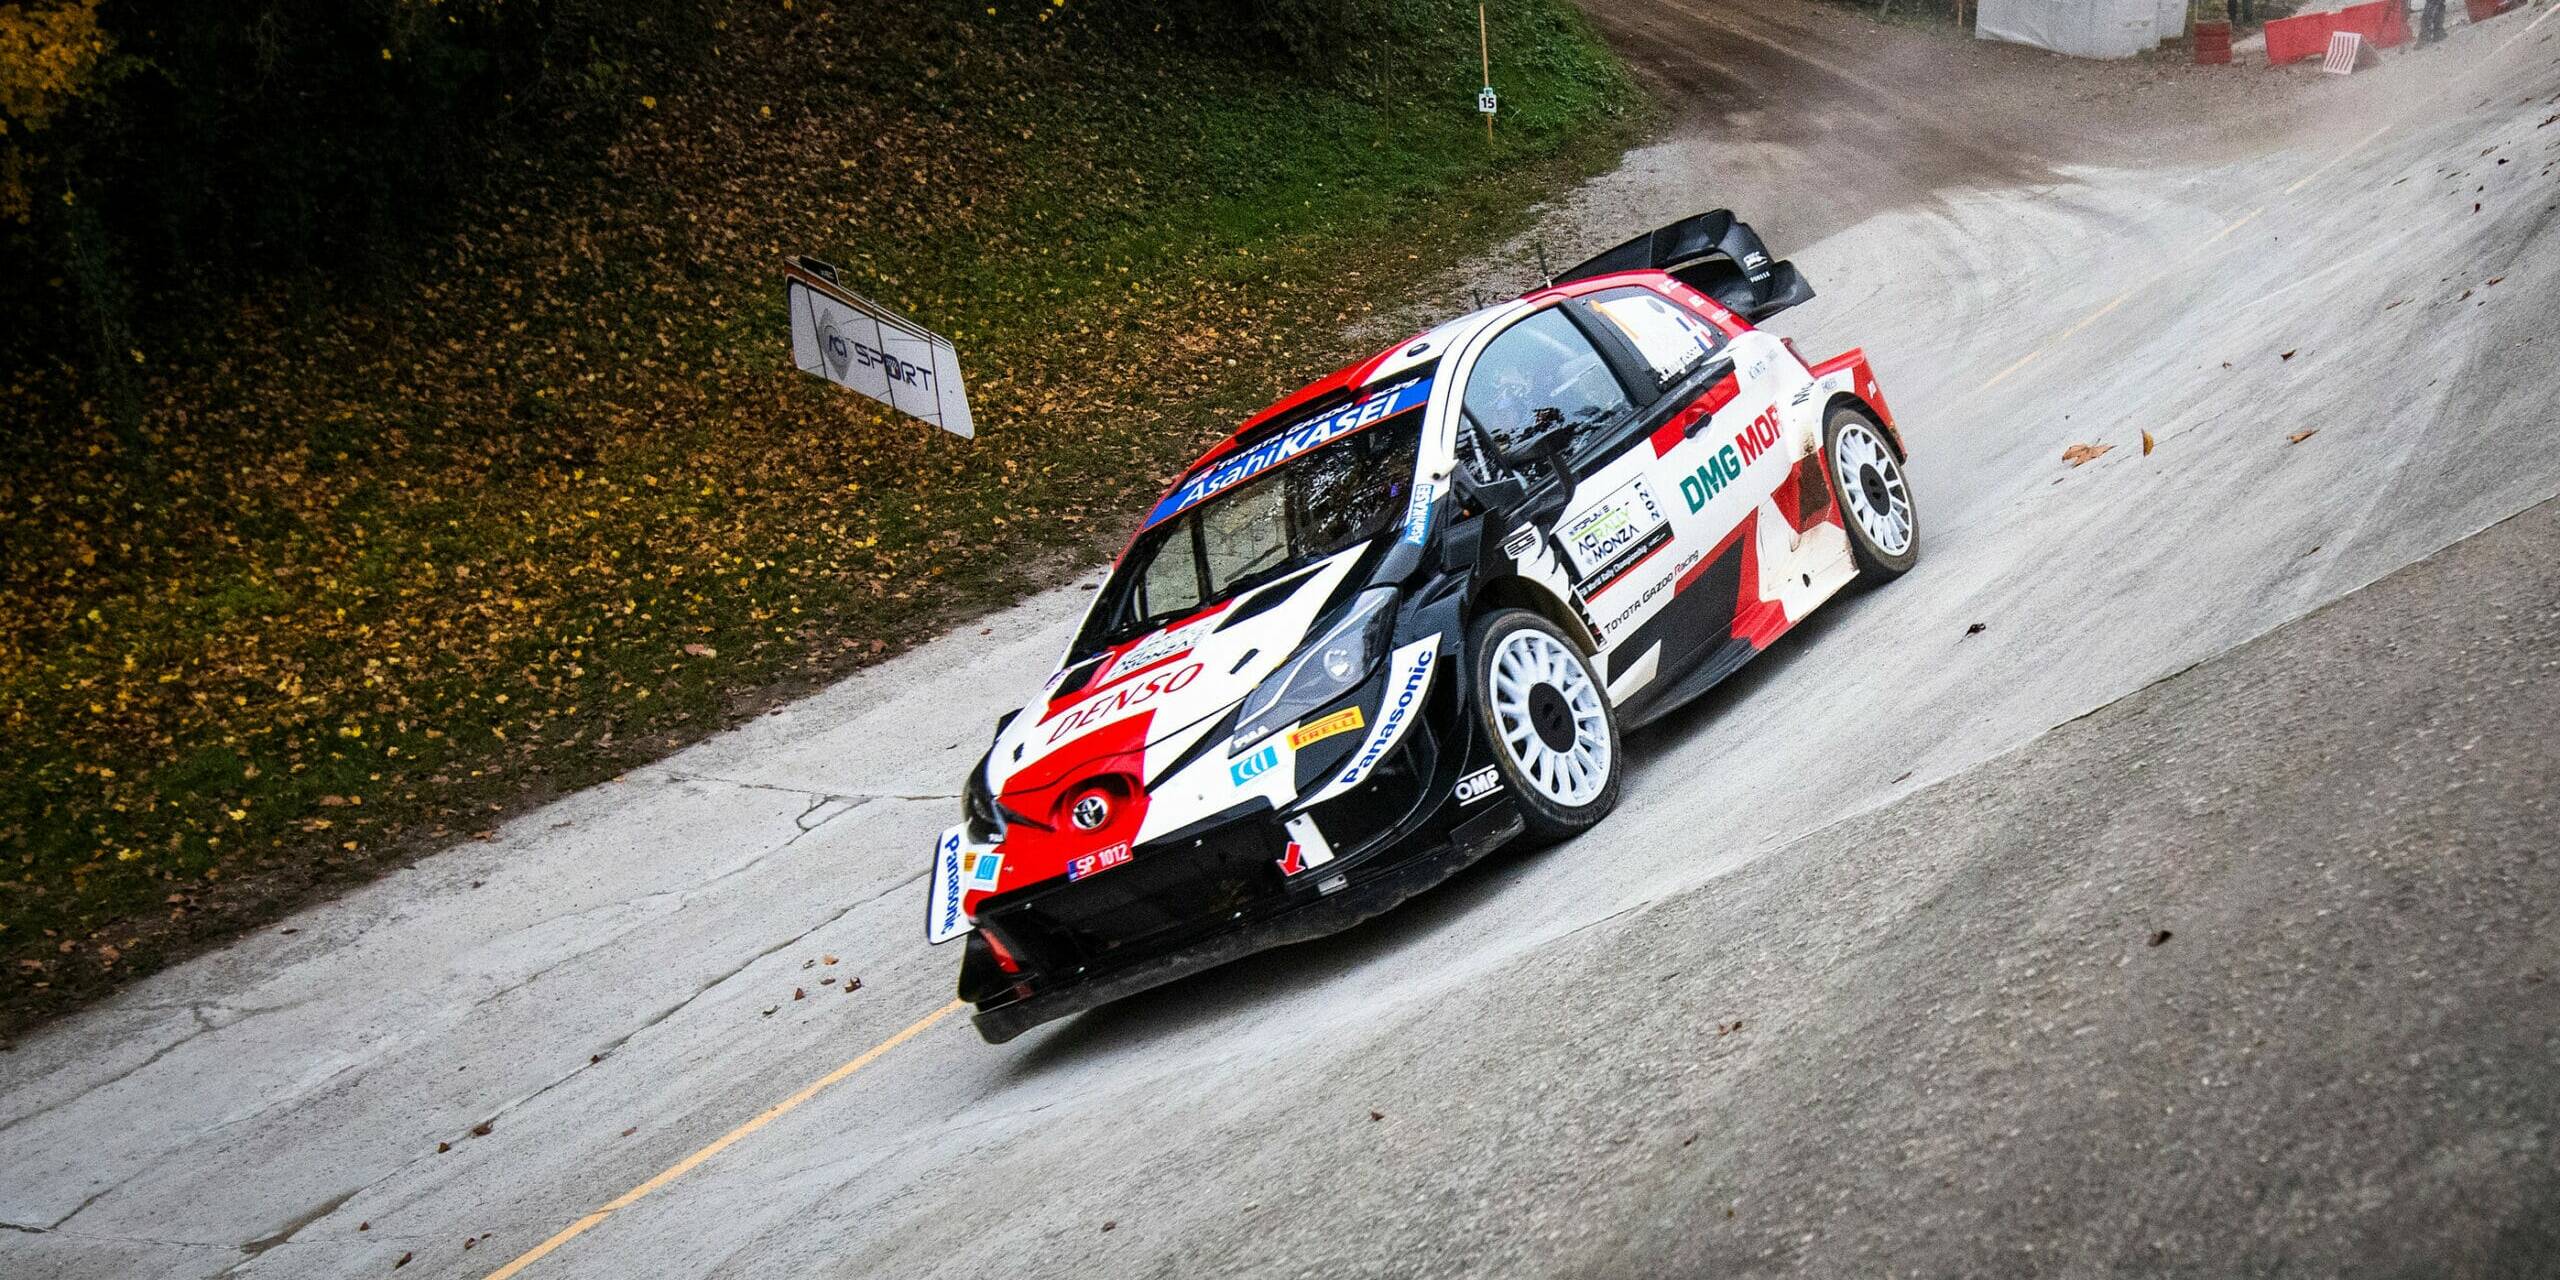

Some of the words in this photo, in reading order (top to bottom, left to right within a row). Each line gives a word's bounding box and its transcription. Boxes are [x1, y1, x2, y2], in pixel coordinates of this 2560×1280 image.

[1481, 97, 1495, 109] 15
[855, 343, 932, 391] SPORT
[1216, 432, 1284, 469] TOYOTA
[1286, 402, 1354, 437] GAZOO
[1634, 482, 1660, 521] 2021
[1680, 444, 1741, 515] DMG
[1593, 524, 1640, 562] MONZA
[1603, 599, 1642, 635] TOYOTA
[1641, 572, 1674, 604] GAZOO
[1673, 549, 1699, 577] Racing
[1047, 663, 1204, 745] DENSO
[1340, 650, 1433, 783] Panasonic
[1292, 712, 1357, 746] PIRELLI
[1455, 769, 1500, 800] OMP
[1076, 855, 1096, 875] SP
[1098, 843, 1130, 868] 1012
[941, 833, 961, 935] Panasonic
